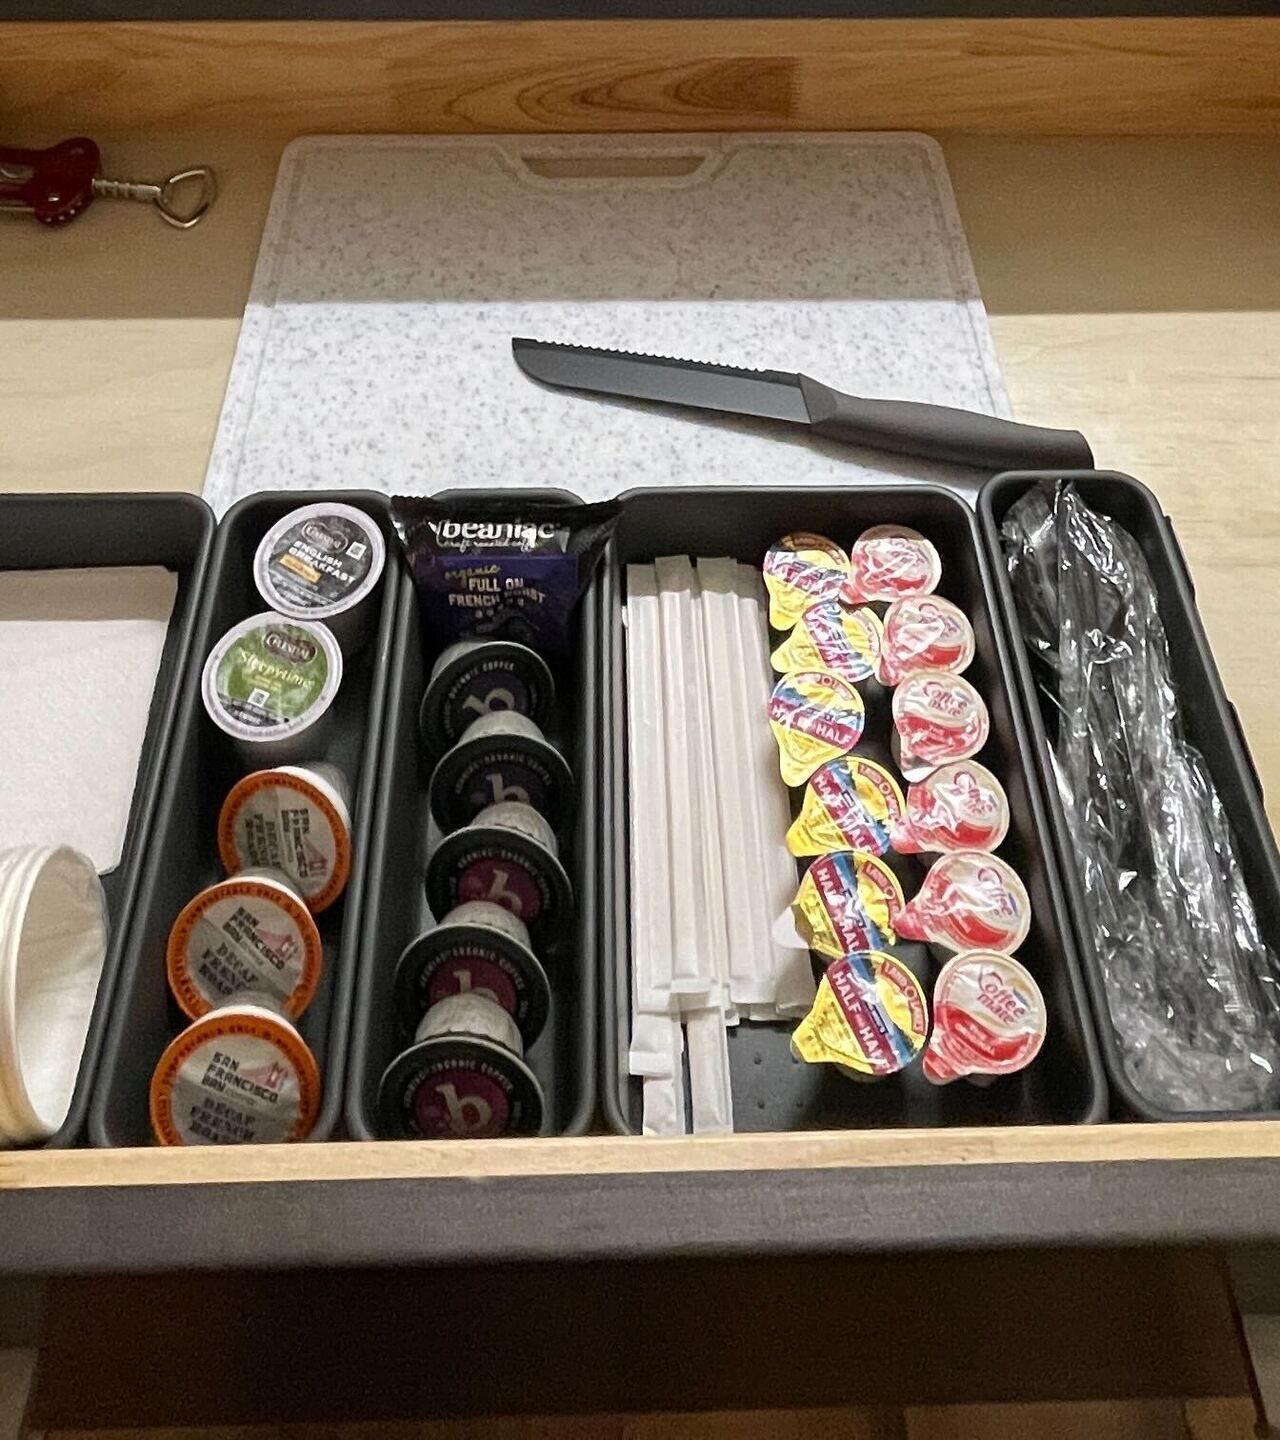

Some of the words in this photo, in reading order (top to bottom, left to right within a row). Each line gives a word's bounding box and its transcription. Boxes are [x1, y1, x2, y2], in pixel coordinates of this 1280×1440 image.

[288, 546, 356, 585] BREAKFAST
[293, 540, 343, 568] ENGLISH
[448, 592, 500, 609] FRENCH
[469, 577, 501, 592] FULL
[505, 577, 525, 590] ON
[816, 723, 853, 745] HALF
[230, 913, 286, 971] FRANCISCO
[839, 919, 861, 954] HAL
[832, 970, 862, 1015] HALF
[978, 971, 1026, 1017] Coffee
[213, 1051, 240, 1072] SAN
[207, 1063, 280, 1104] FRANCISCO
